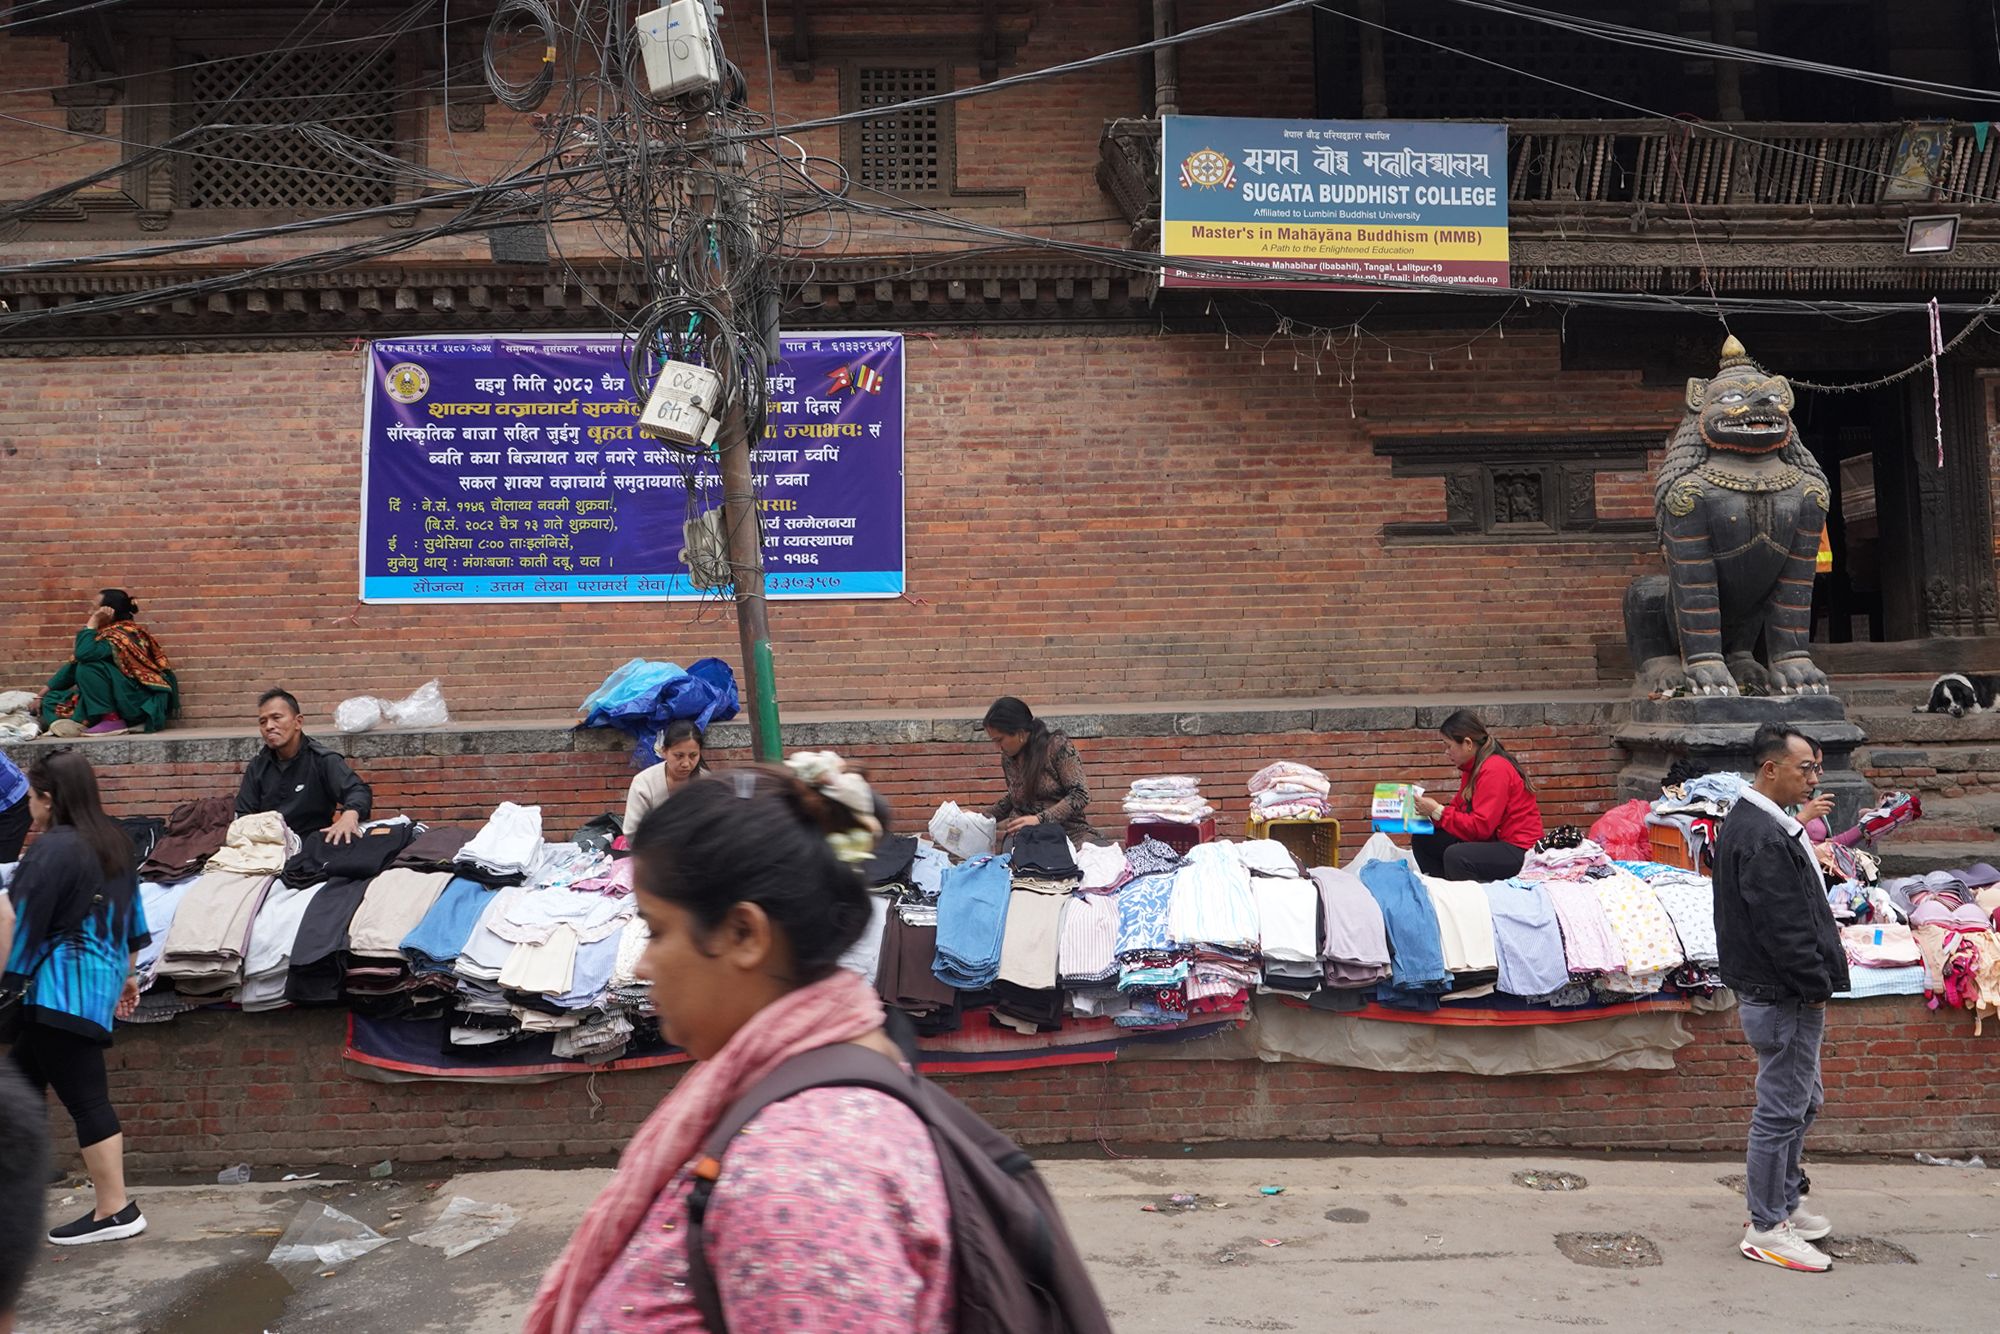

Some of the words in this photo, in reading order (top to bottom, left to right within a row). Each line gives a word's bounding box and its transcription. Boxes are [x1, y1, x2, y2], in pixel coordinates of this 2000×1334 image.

[1242, 182, 1315, 203] SUGATA
[1319, 184, 1409, 205] BUDDHIST
[1414, 186, 1496, 207] COLLEGE
[1253, 208, 1291, 218] Affiliated
[1293, 209, 1302, 218] to
[1303, 208, 1337, 219] Lumbini
[1339, 209, 1377, 220] Buddhist
[1379, 209, 1421, 222] University
[1192, 225, 1254, 240] Master's
[1259, 226, 1273, 240] in
[1357, 228, 1429, 243] Buddhism
[1433, 230, 1482, 246] (MMB)
[1261, 244, 1268, 252] A
[1269, 244, 1289, 253] Path
[1290, 245, 1299, 253] to
[1302, 244, 1317, 254] the
[1319, 244, 1372, 256] Enlightened
[1373, 246, 1415, 255] Education
[1272, 260, 1317, 270] Mahabihar
[1396, 263, 1443, 274] Lalitpur-19
[1412, 273, 1498, 286] info@sugata.edu.np
[512, 374, 546, 392] मिति
[553, 378, 594, 394] २०८२
[601, 373, 625, 391] चैत्र
[428, 402, 490, 418] शाक्य
[462, 426, 497, 441] बाजा
[503, 423, 540, 441] सहित
[470, 452, 501, 465] कया
[575, 451, 600, 466] यल
[605, 448, 638, 467] नगरे
[459, 476, 498, 491] सकल
[504, 476, 544, 491] शाक्य
[456, 502, 485, 513] ११४६
[538, 496, 570, 512] नवमी
[466, 520, 494, 531] २०८२
[500, 515, 519, 531] चैत्र
[524, 520, 539, 532] १३
[544, 515, 564, 530] गते
[520, 553, 548, 568] काती
[580, 556, 601, 568] यल
[412, 578, 465, 594] सौजन्य
[534, 577, 568, 592] लेखा
